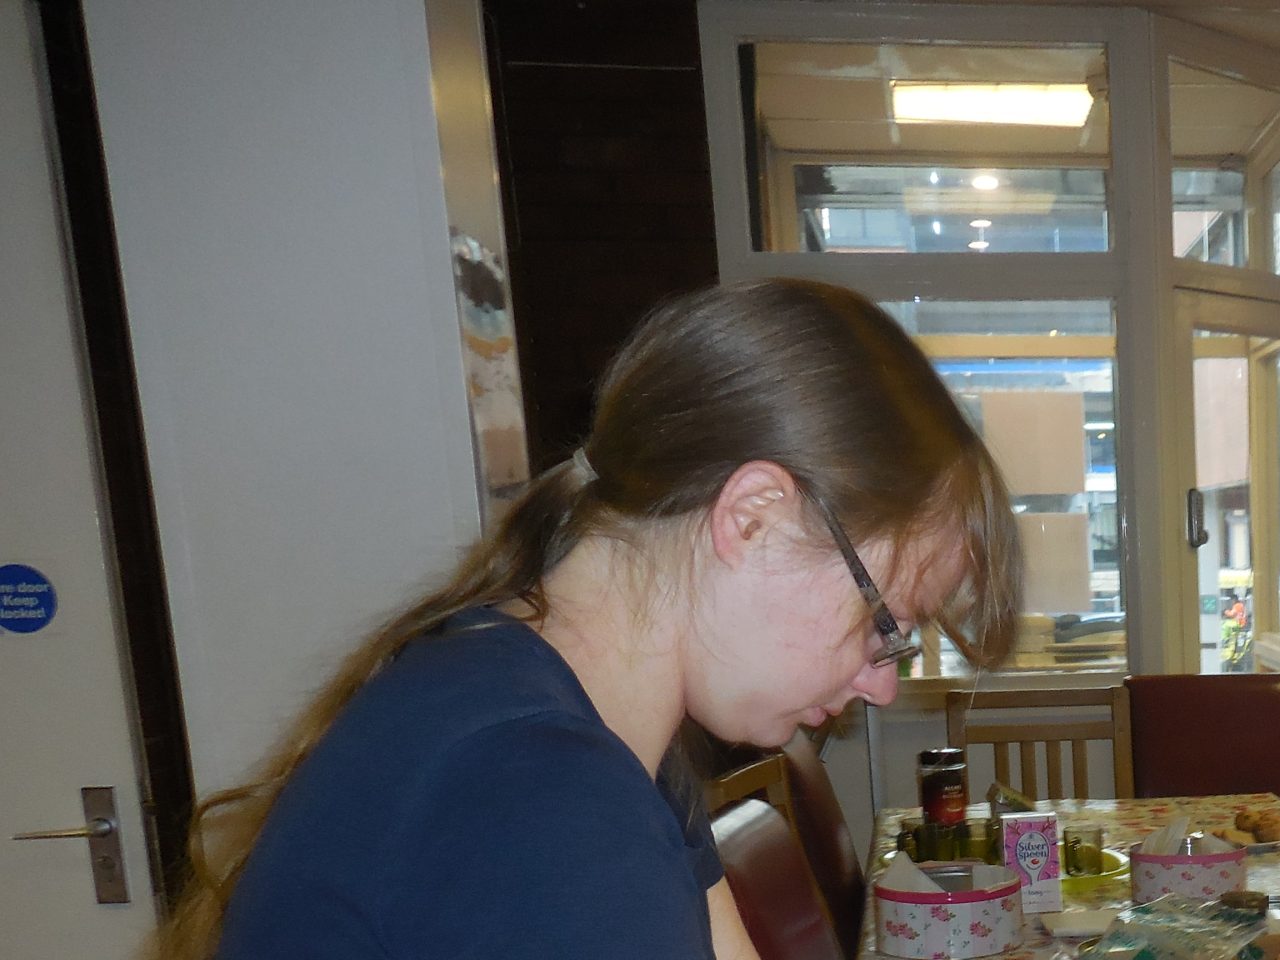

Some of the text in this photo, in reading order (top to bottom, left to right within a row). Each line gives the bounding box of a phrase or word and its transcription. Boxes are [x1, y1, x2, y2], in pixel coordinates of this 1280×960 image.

[17, 582, 49, 593] door
[3, 595, 39, 607] Keep
[0, 607, 46, 619] locked
[1018, 841, 1046, 852] Silver
